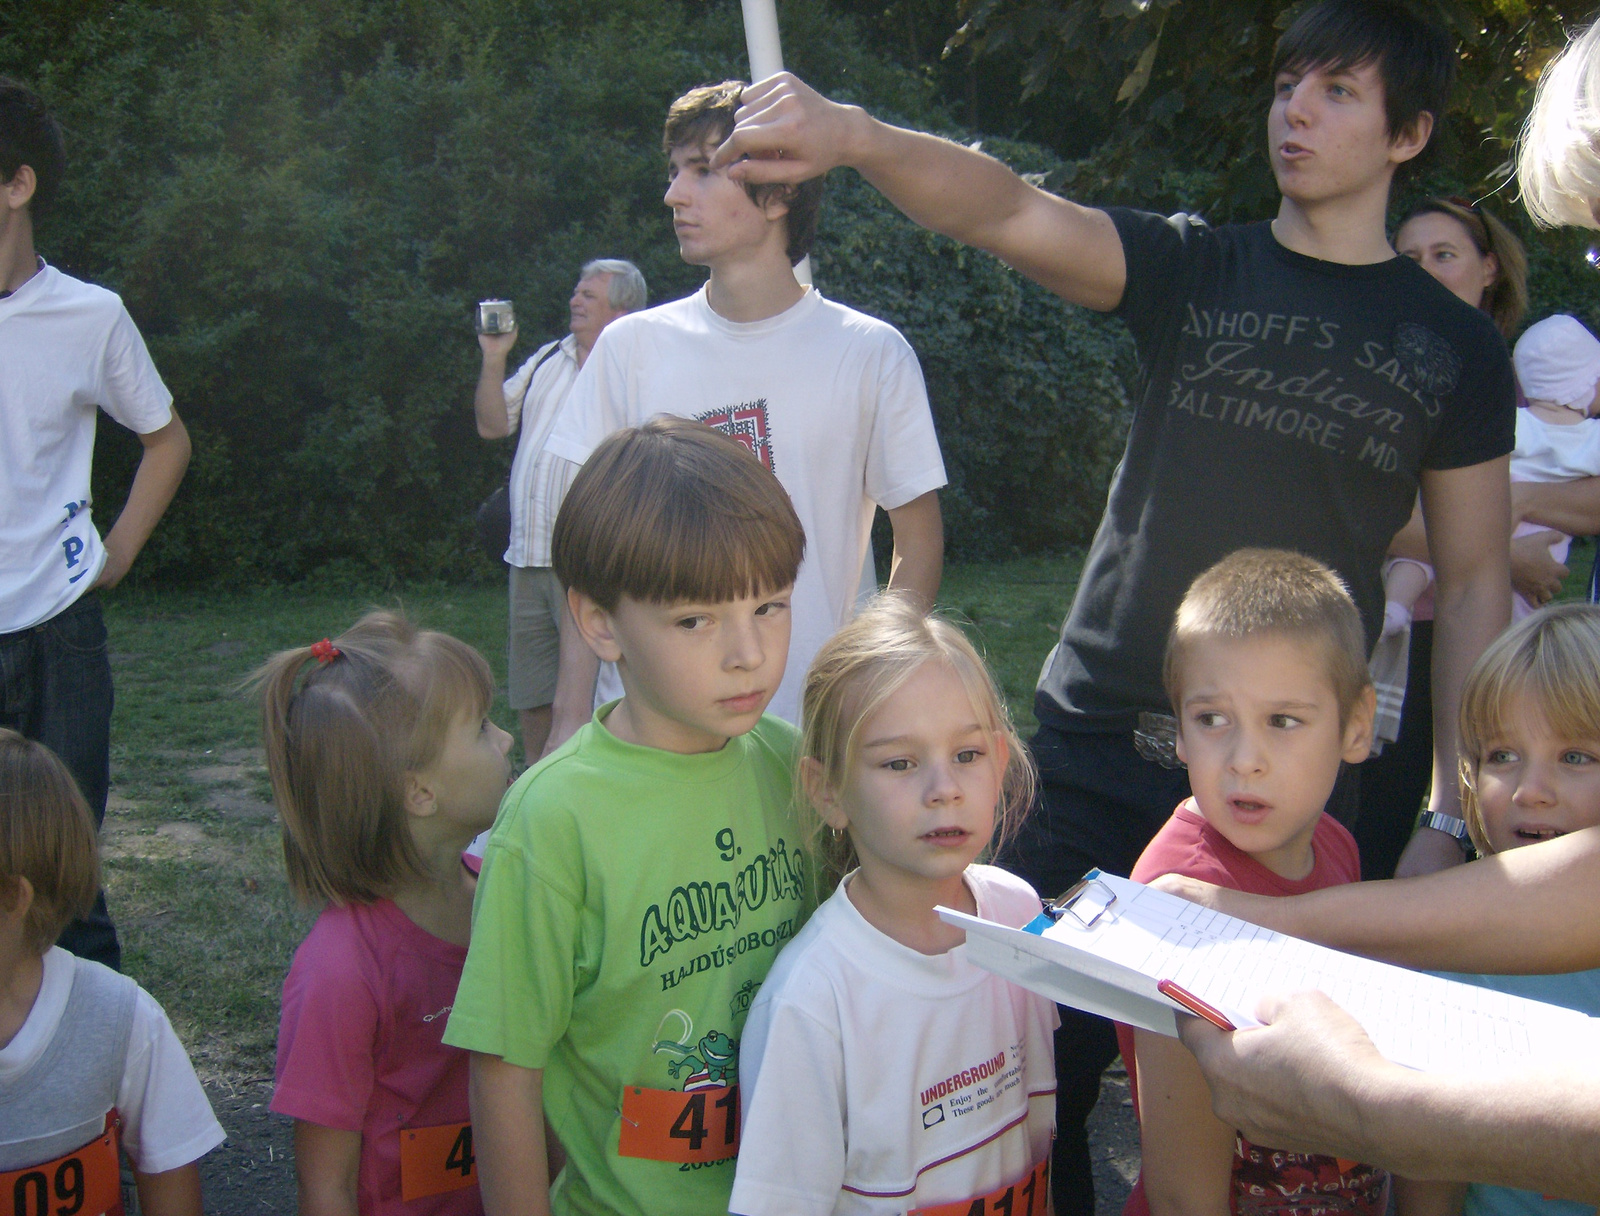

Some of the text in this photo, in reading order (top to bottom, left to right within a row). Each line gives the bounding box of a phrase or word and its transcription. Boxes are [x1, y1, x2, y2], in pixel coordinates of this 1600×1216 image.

[1181, 341, 1405, 434] Indian
[1357, 436, 1399, 473] MD
[715, 828, 742, 862] 9.
[920, 1051, 1006, 1106] UNDERGROUND
[949, 1094, 973, 1108] Enjoy
[977, 1086, 989, 1097] the
[952, 1105, 975, 1117] These
[976, 1095, 995, 1109] goods
[13, 1157, 86, 1216] 09
